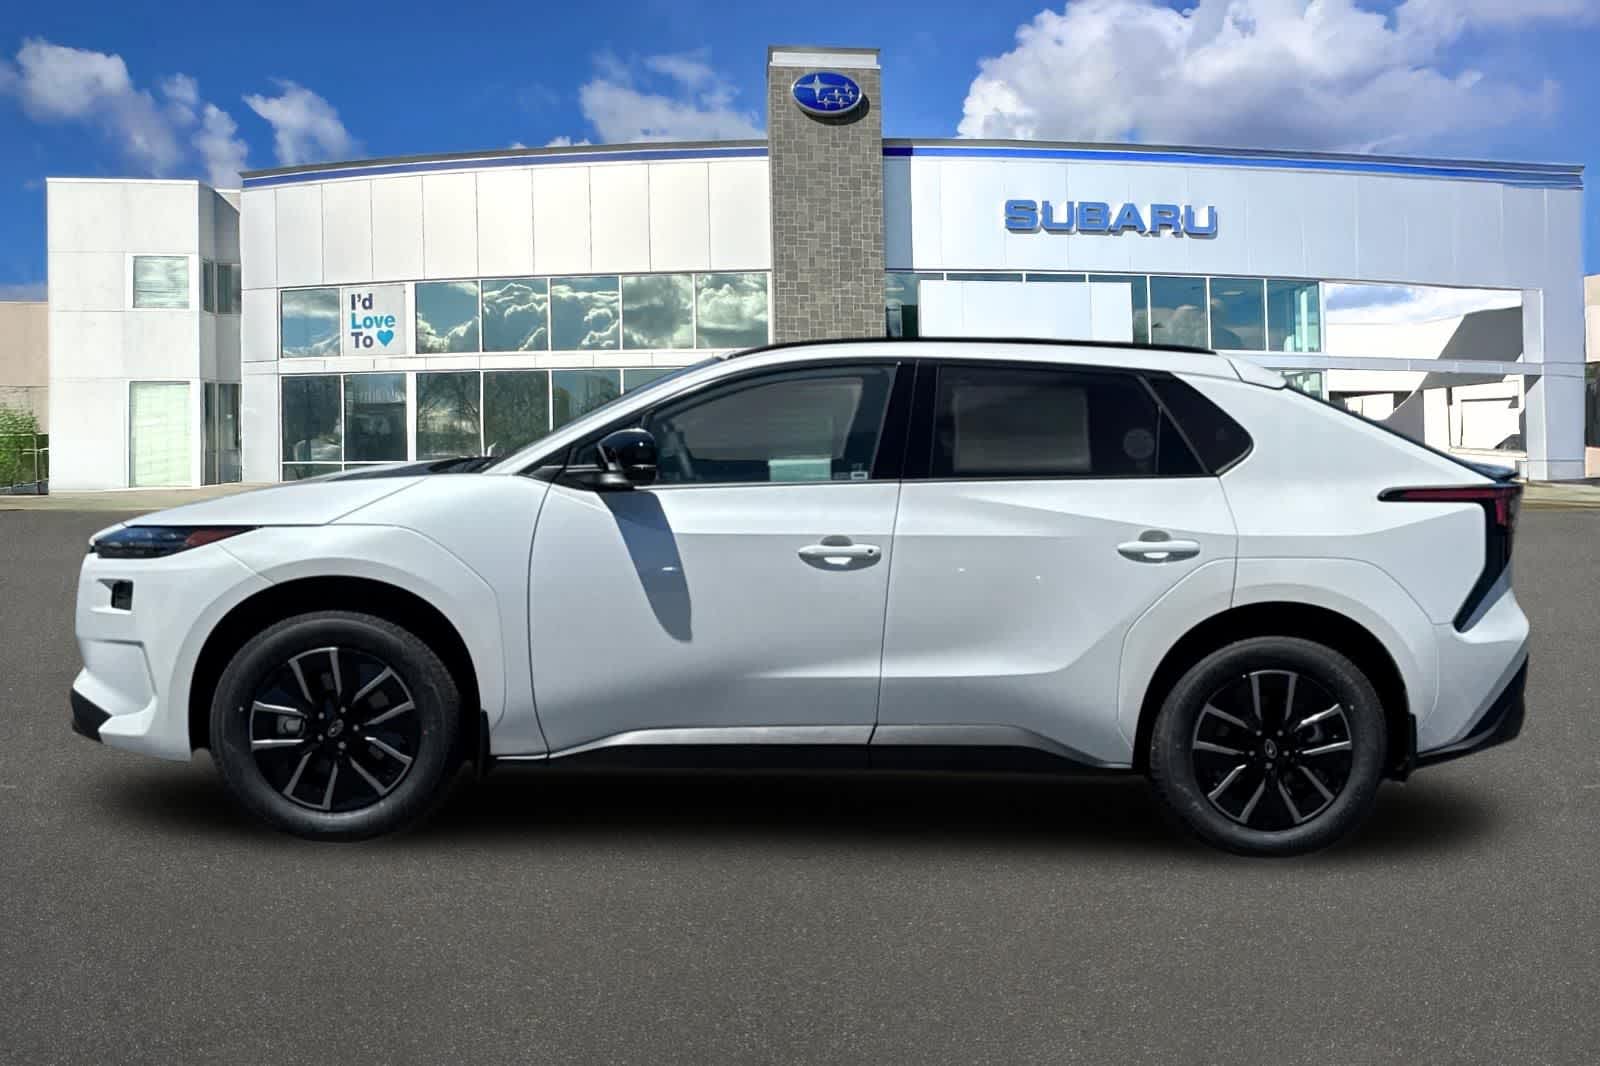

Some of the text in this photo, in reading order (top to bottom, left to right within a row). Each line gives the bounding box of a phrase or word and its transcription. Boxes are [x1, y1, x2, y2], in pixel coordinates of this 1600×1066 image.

[1004, 199, 1218, 237] SUBARU
[350, 293, 373, 311] I'd
[351, 312, 396, 330] Love
[350, 331, 374, 349] To
